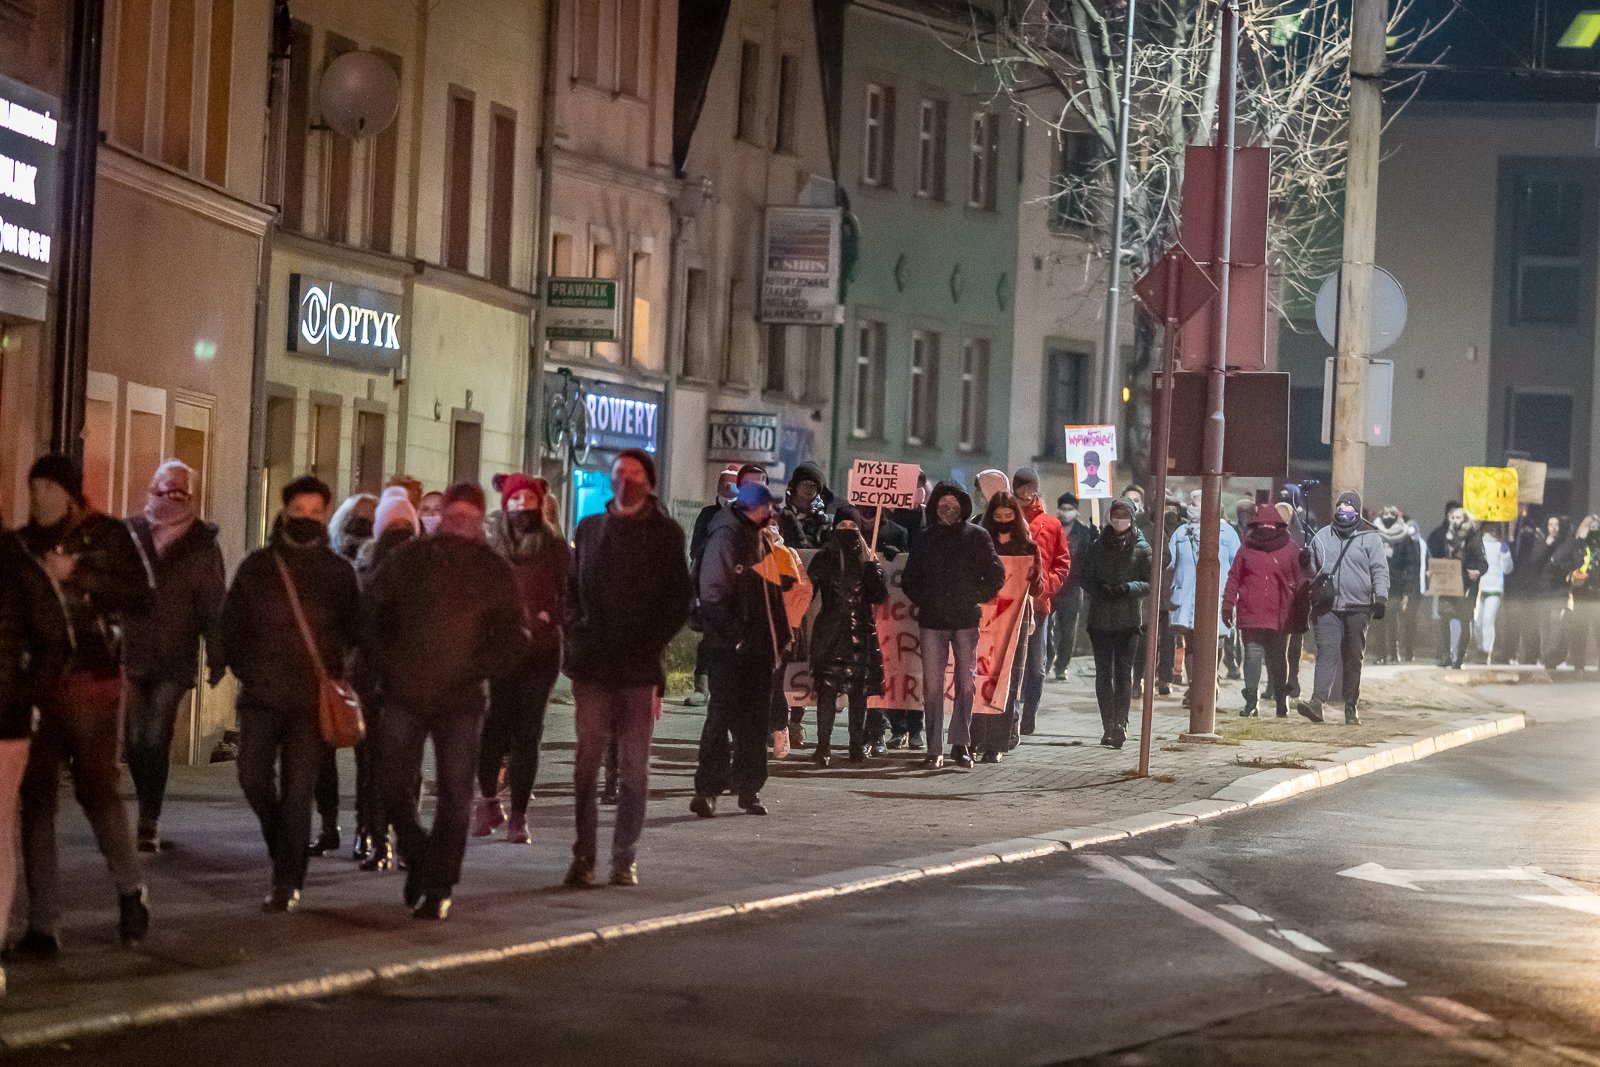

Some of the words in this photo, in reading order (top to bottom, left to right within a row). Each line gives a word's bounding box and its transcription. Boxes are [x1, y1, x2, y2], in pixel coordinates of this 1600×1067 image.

[551, 282, 608, 297] PRAWNIK
[330, 302, 401, 350] OPTYK
[586, 393, 657, 437] ROWERY
[711, 424, 773, 451] KSERO
[857, 462, 899, 477] MYŚLĘ
[860, 476, 898, 490] CZUJĘ
[851, 491, 913, 508] DECYDUJĘ
